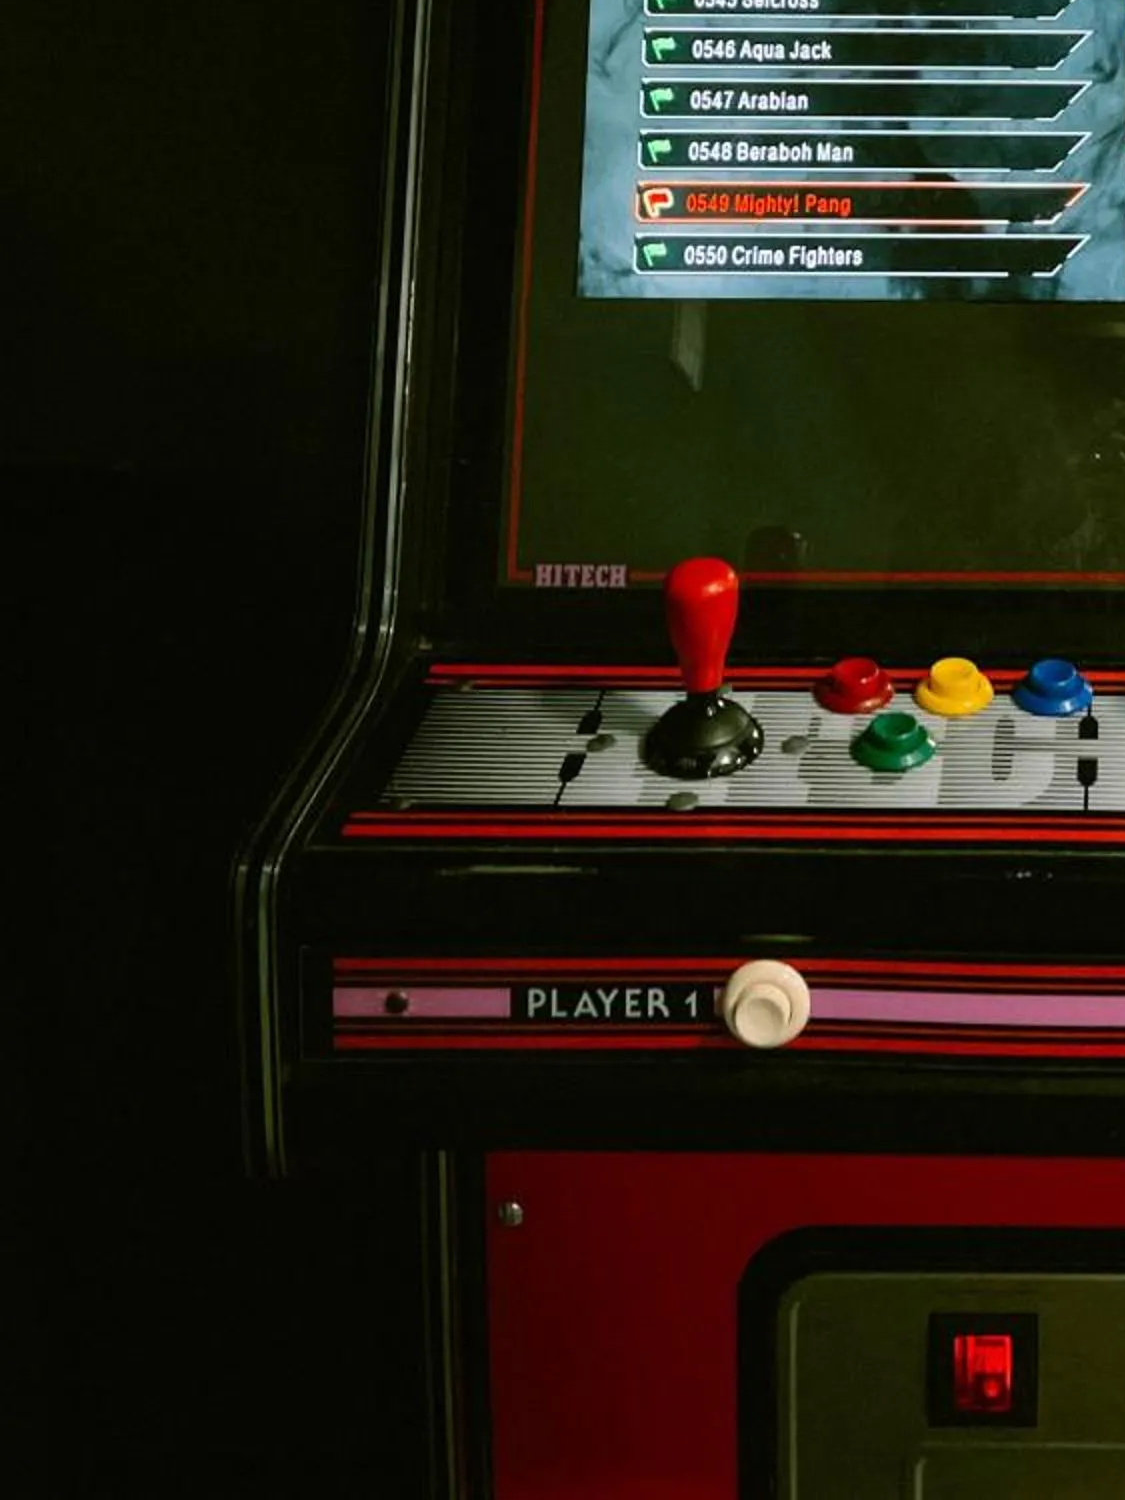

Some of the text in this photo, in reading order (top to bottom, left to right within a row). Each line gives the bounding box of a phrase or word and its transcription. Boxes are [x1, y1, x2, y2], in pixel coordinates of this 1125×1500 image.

[692, 40, 832, 64] 0546 Aqua Jack
[690, 91, 809, 111] 0547 Arabian
[688, 142, 854, 163] 0548 Beraboh Man
[686, 194, 852, 219] 0549 Mighty! Pang
[684, 245, 863, 272] 0550 Crime Fighters
[535, 564, 627, 588] HITECH
[526, 988, 698, 1018] PLAYER 1
